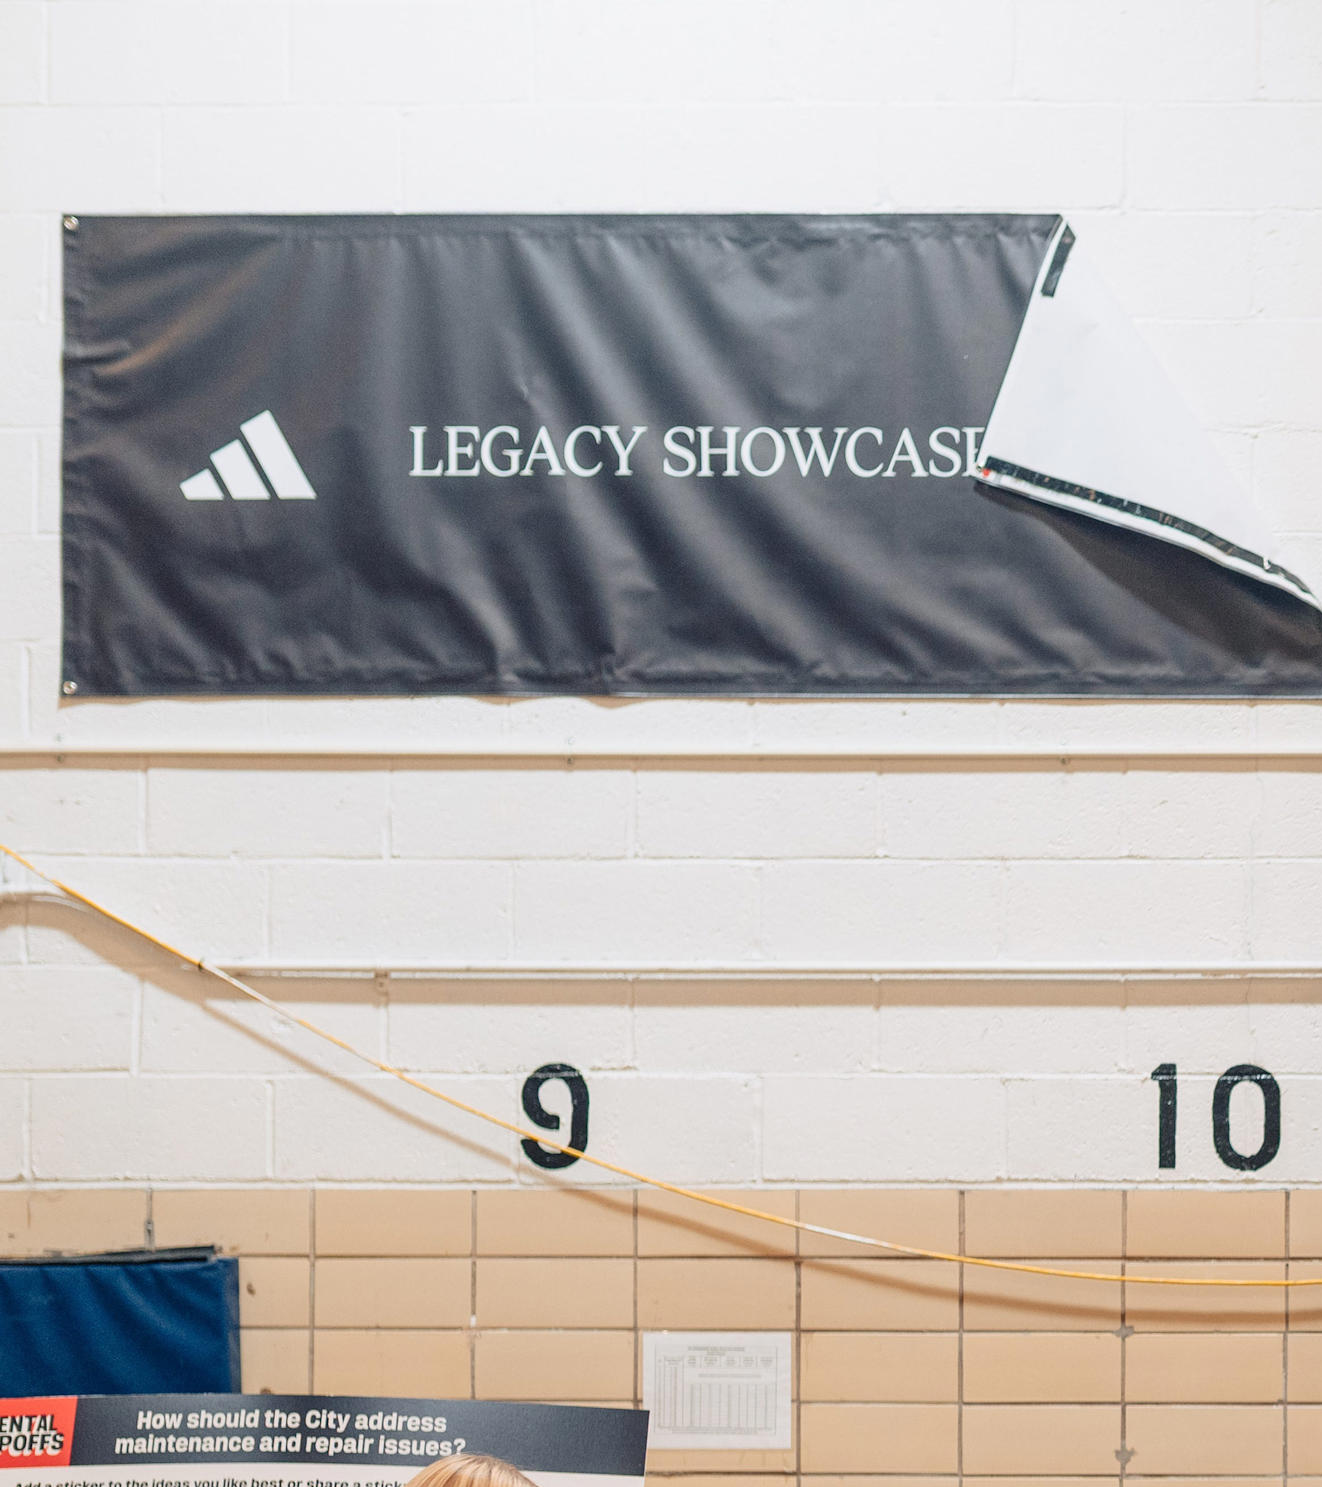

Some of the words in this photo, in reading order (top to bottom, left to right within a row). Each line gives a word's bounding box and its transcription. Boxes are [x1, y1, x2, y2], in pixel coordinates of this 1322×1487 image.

[409, 425, 648, 477] LEGACY
[520, 1063, 590, 1170] 9
[1152, 1063, 1282, 1171] 10
[114, 1433, 255, 1454] maintenance
[258, 1433, 301, 1452] and
[305, 1433, 374, 1456] repair
[378, 1434, 467, 1458] issues?
[136, 1410, 183, 1429] How
[186, 1409, 260, 1429] should
[264, 1409, 300, 1428] the
[305, 1409, 350, 1432] City
[354, 1411, 447, 1432] address
